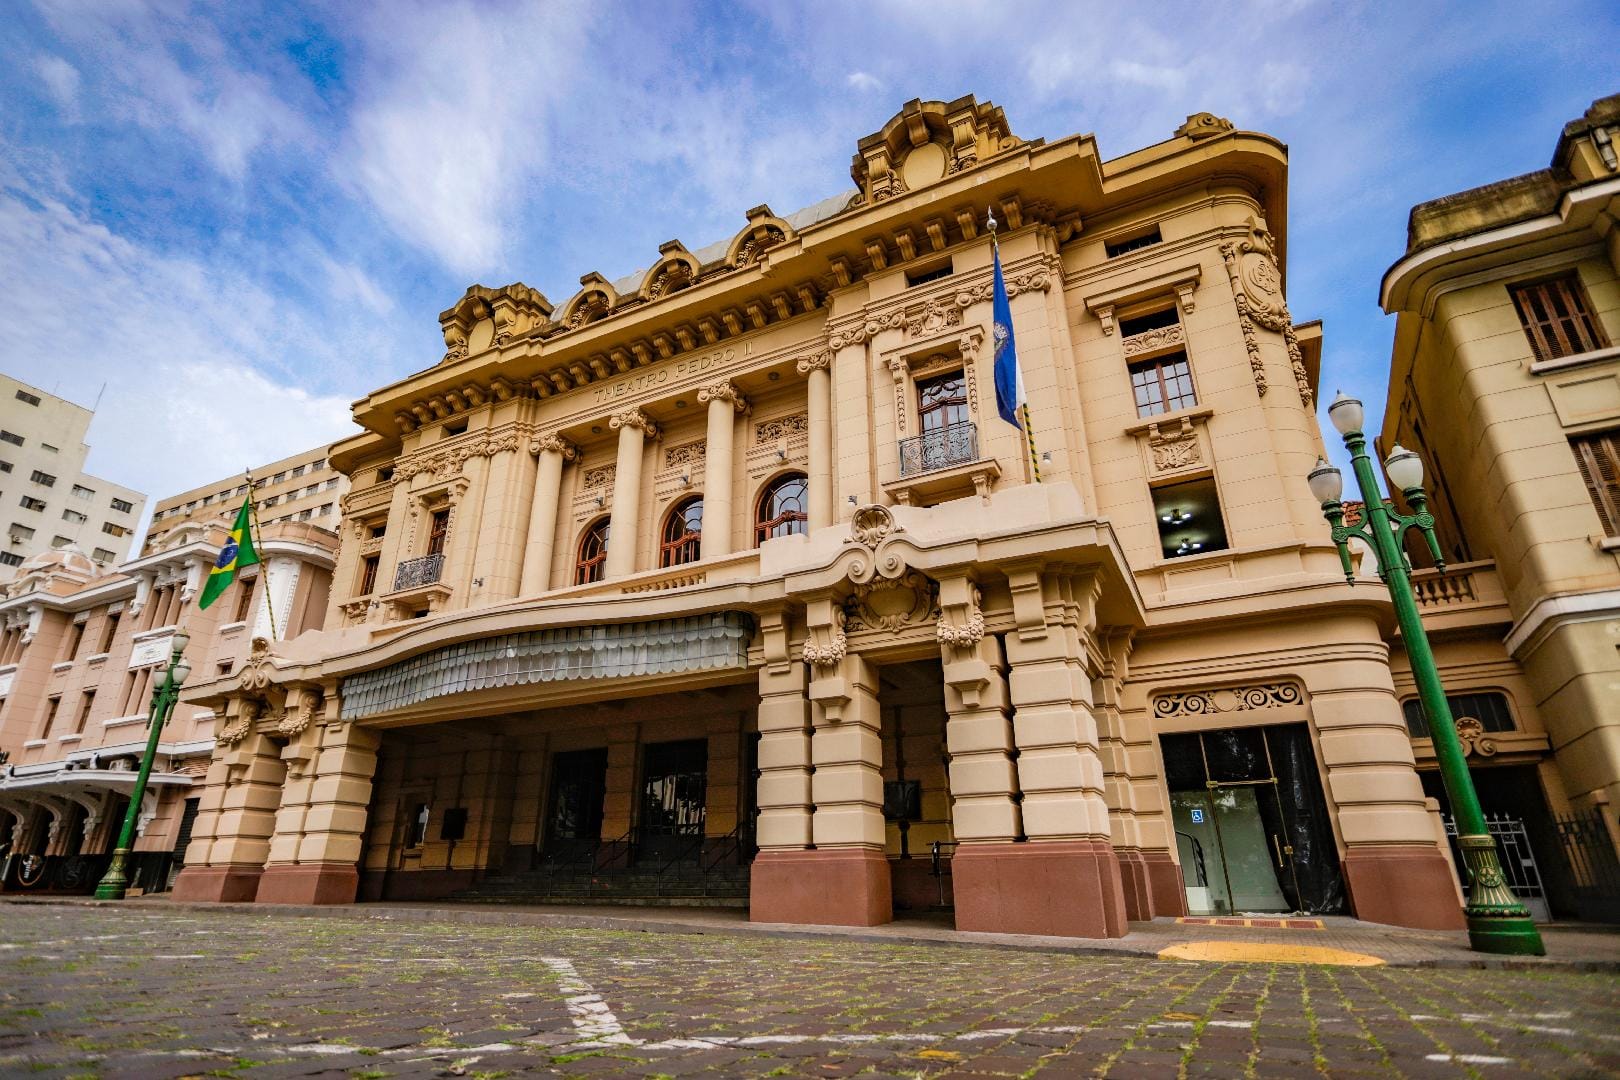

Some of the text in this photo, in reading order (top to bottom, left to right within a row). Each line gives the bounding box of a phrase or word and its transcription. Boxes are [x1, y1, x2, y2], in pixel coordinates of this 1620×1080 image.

[594, 342, 752, 402] THEATRO PEDRO II
